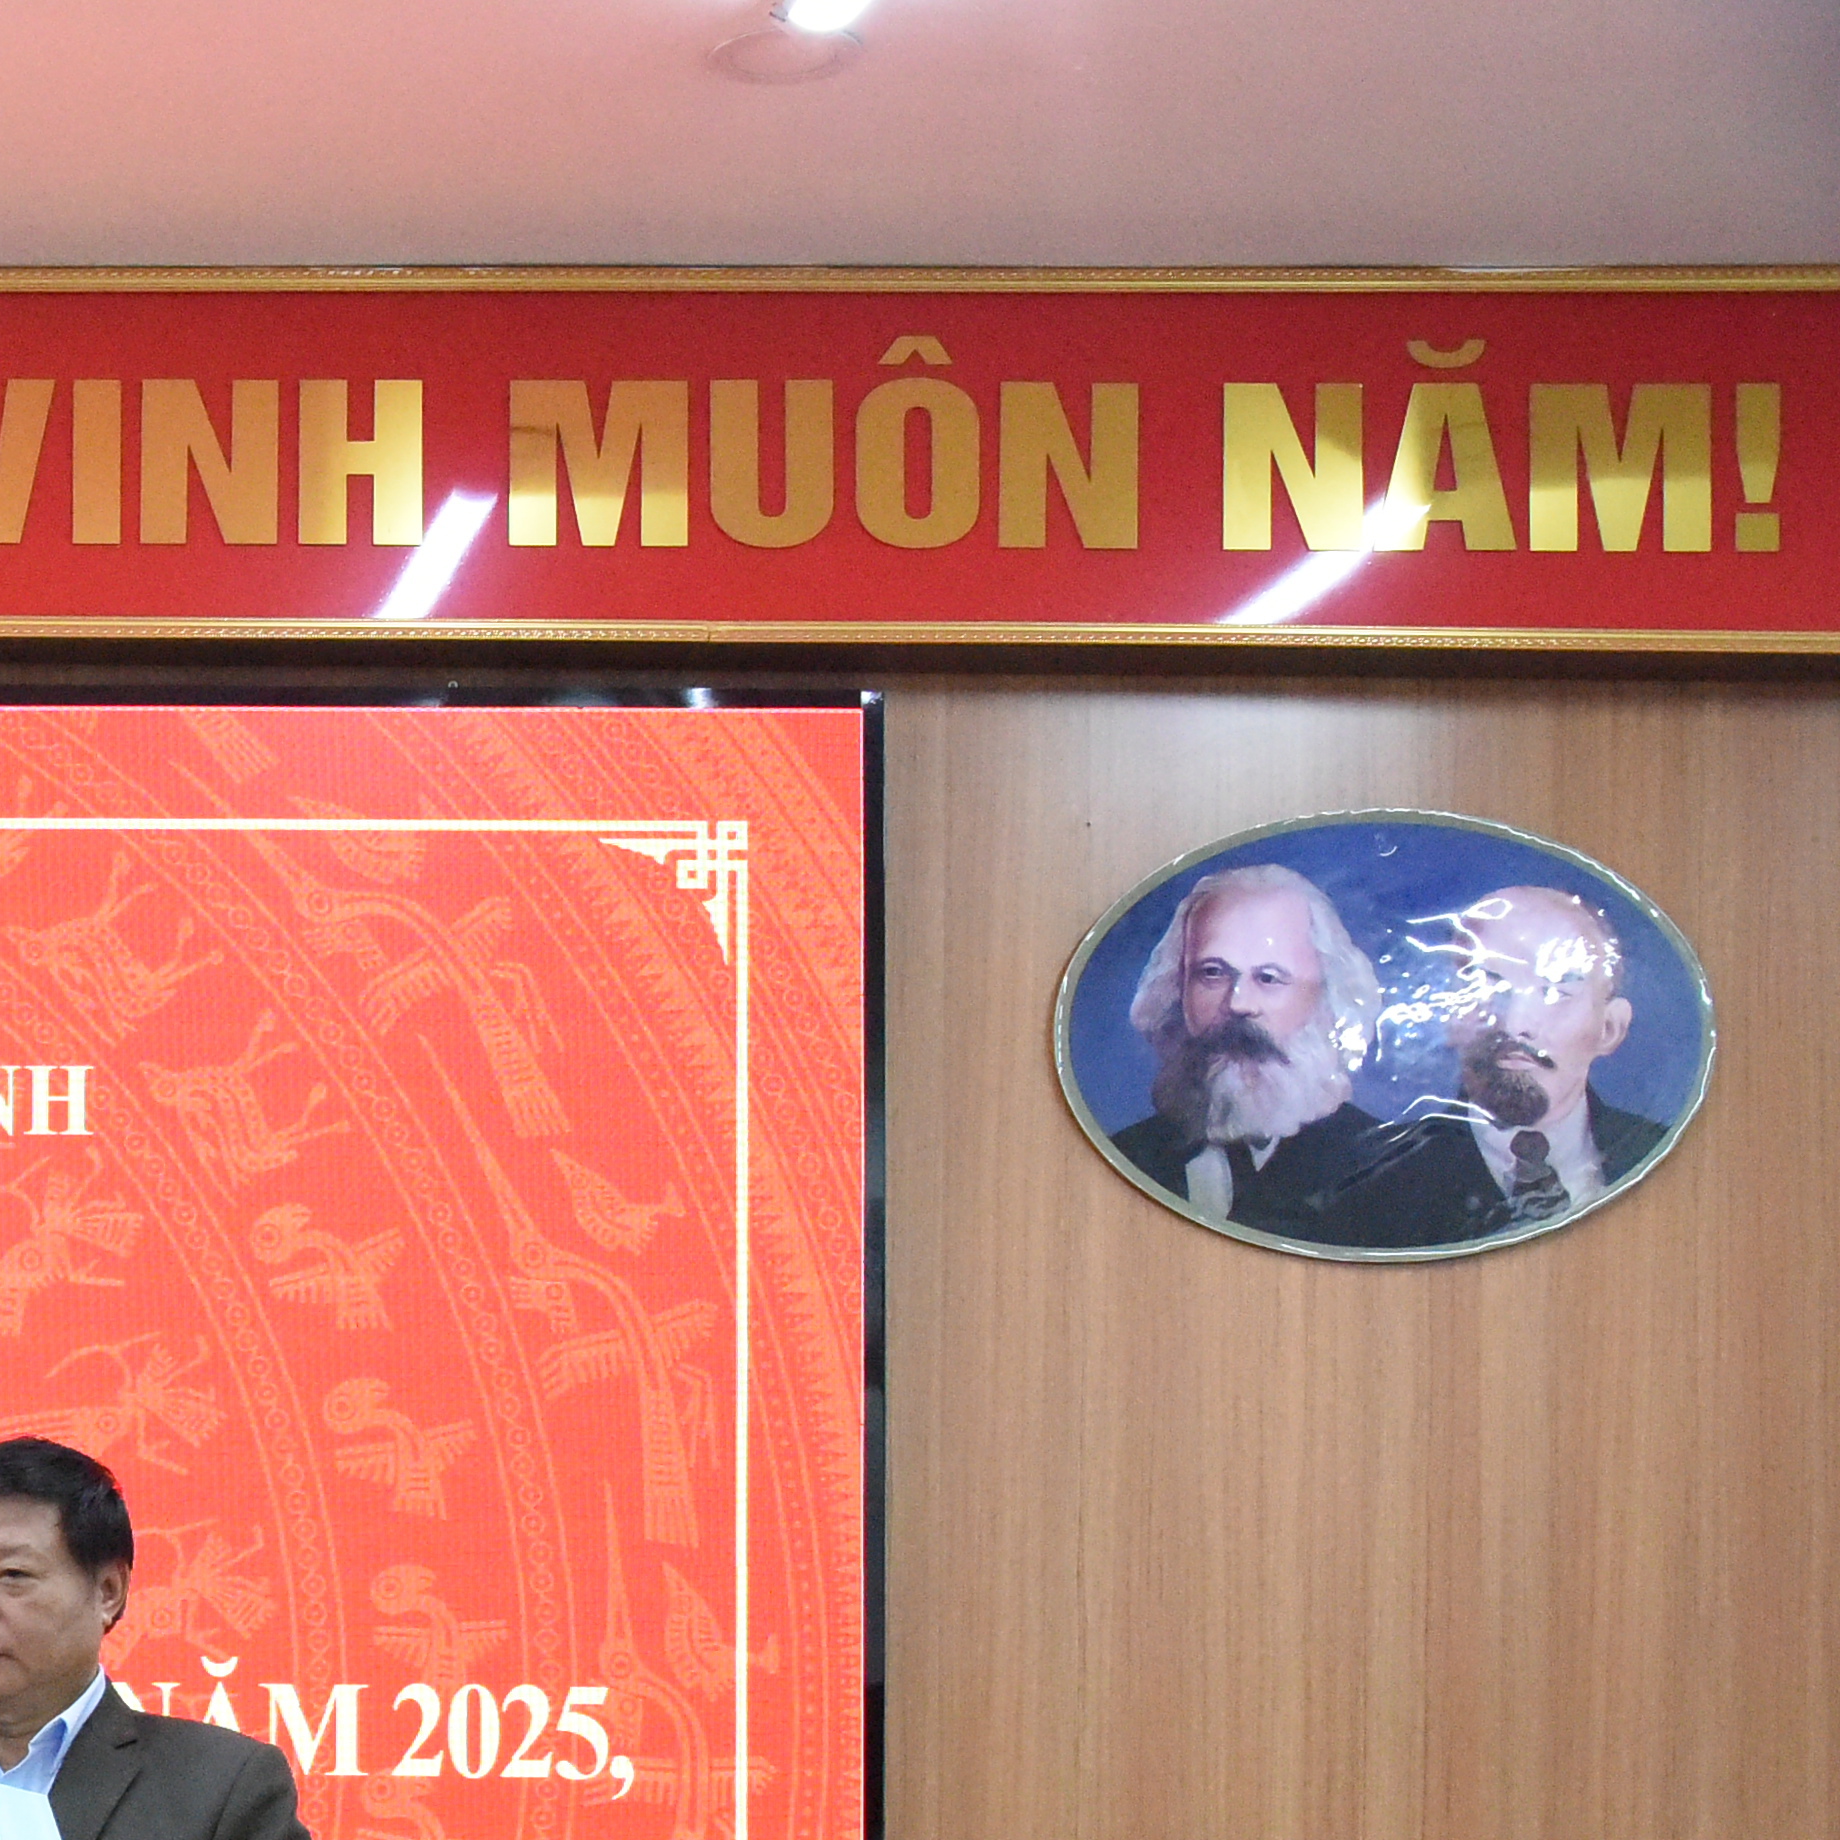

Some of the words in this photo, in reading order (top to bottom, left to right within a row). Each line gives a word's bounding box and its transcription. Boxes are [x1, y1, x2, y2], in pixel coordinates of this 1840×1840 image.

[506, 335, 1140, 550] MUÔN
[1223, 339, 1781, 553] NĂM!
[392, 1683, 636, 1801] 2025,
